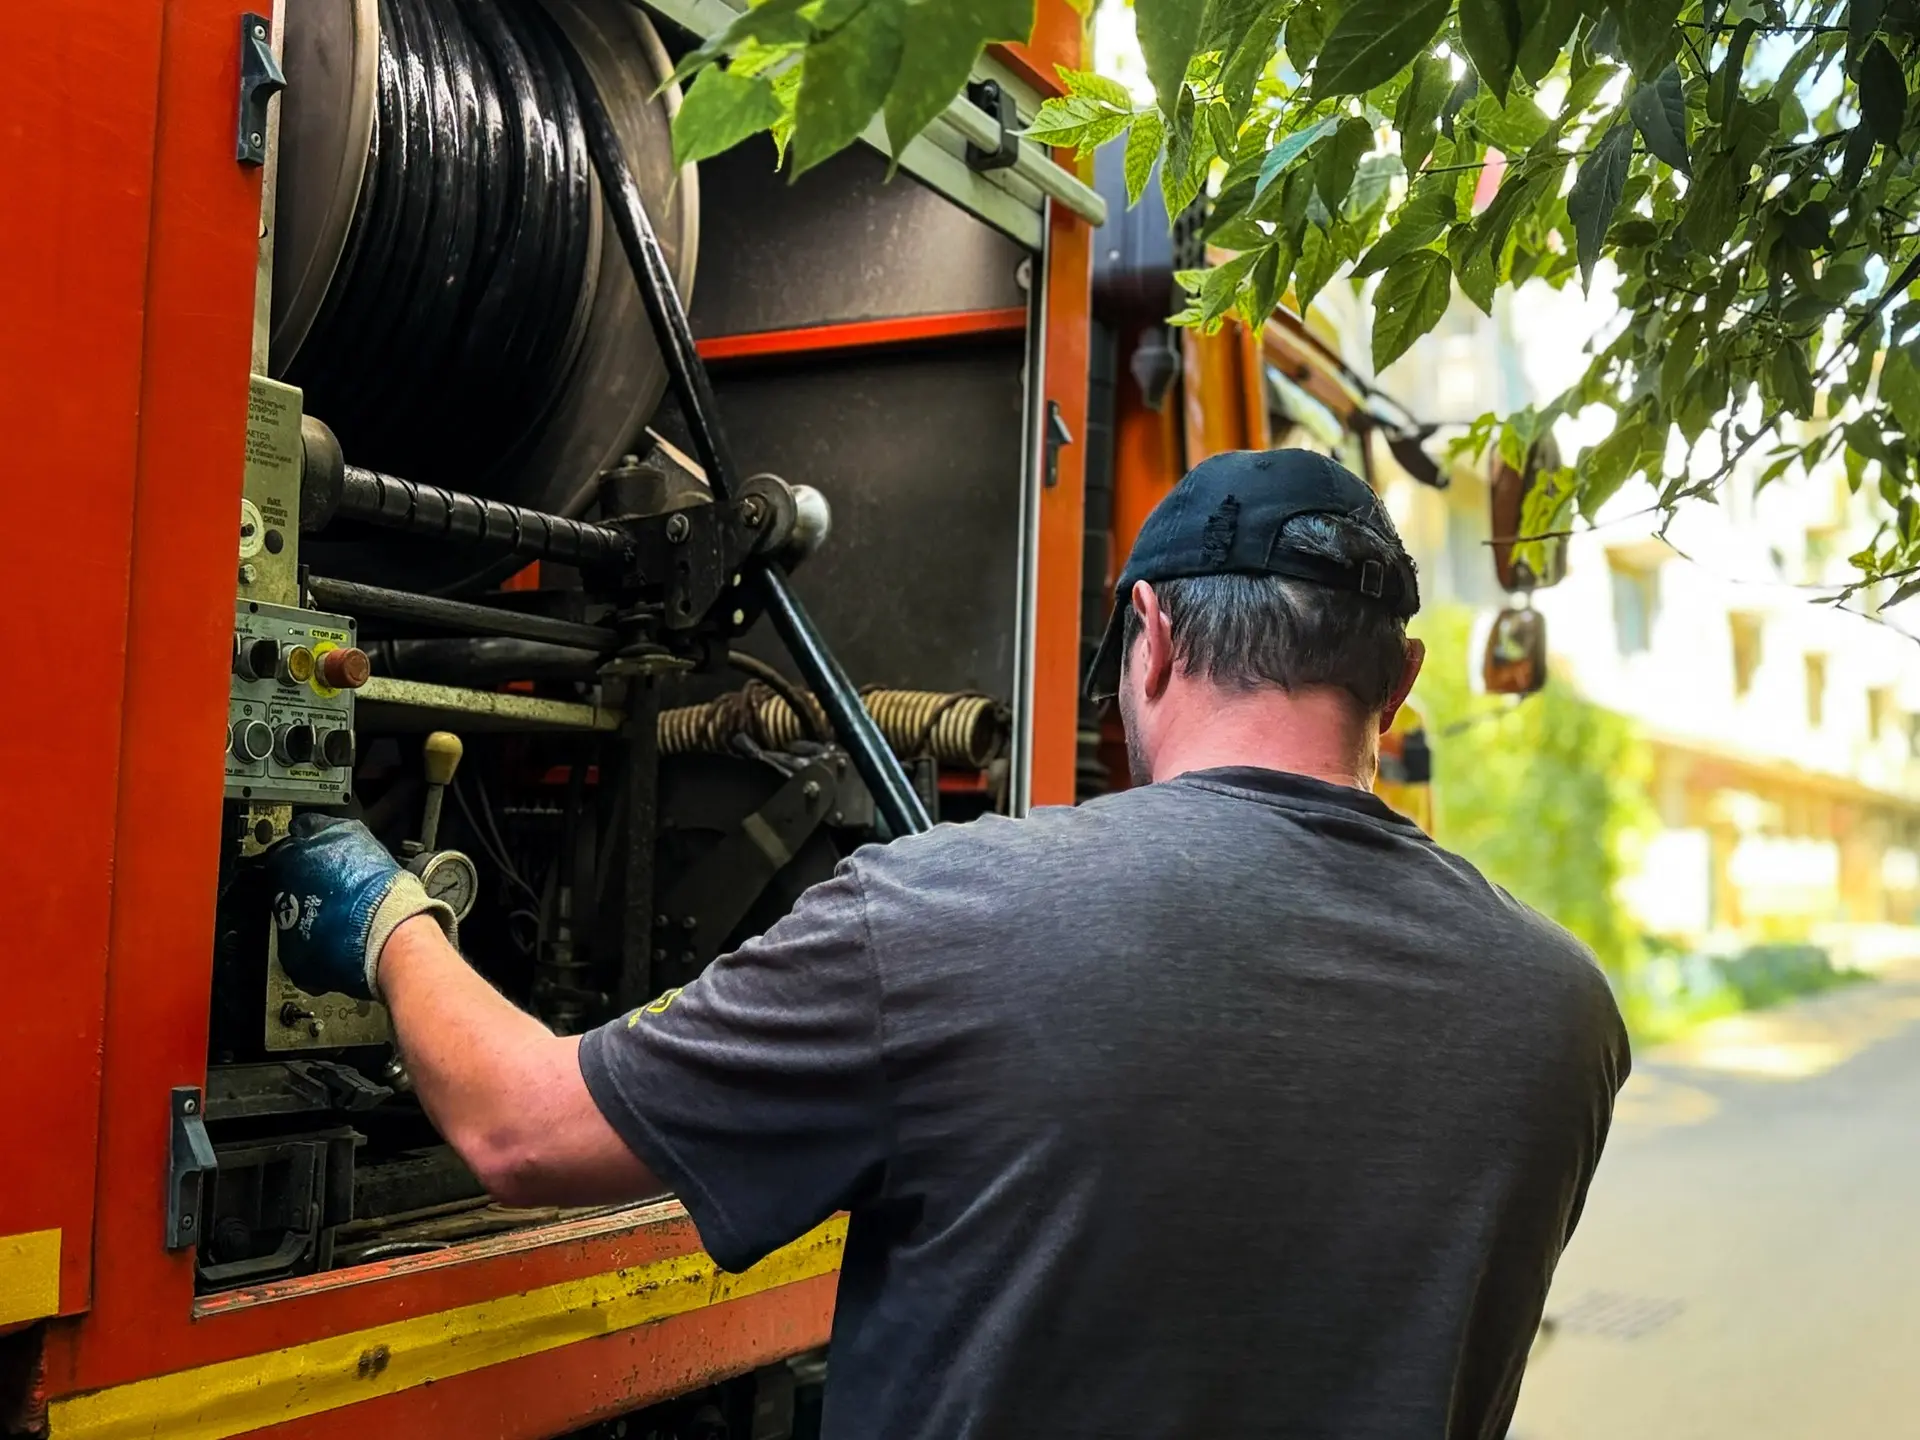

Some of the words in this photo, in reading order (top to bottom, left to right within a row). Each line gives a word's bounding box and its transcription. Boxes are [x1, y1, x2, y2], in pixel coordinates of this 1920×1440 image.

[311, 629, 329, 638] СТОП
[329, 632, 344, 641] ДВС
[289, 768, 321, 778] ЦИСТЕРНА
